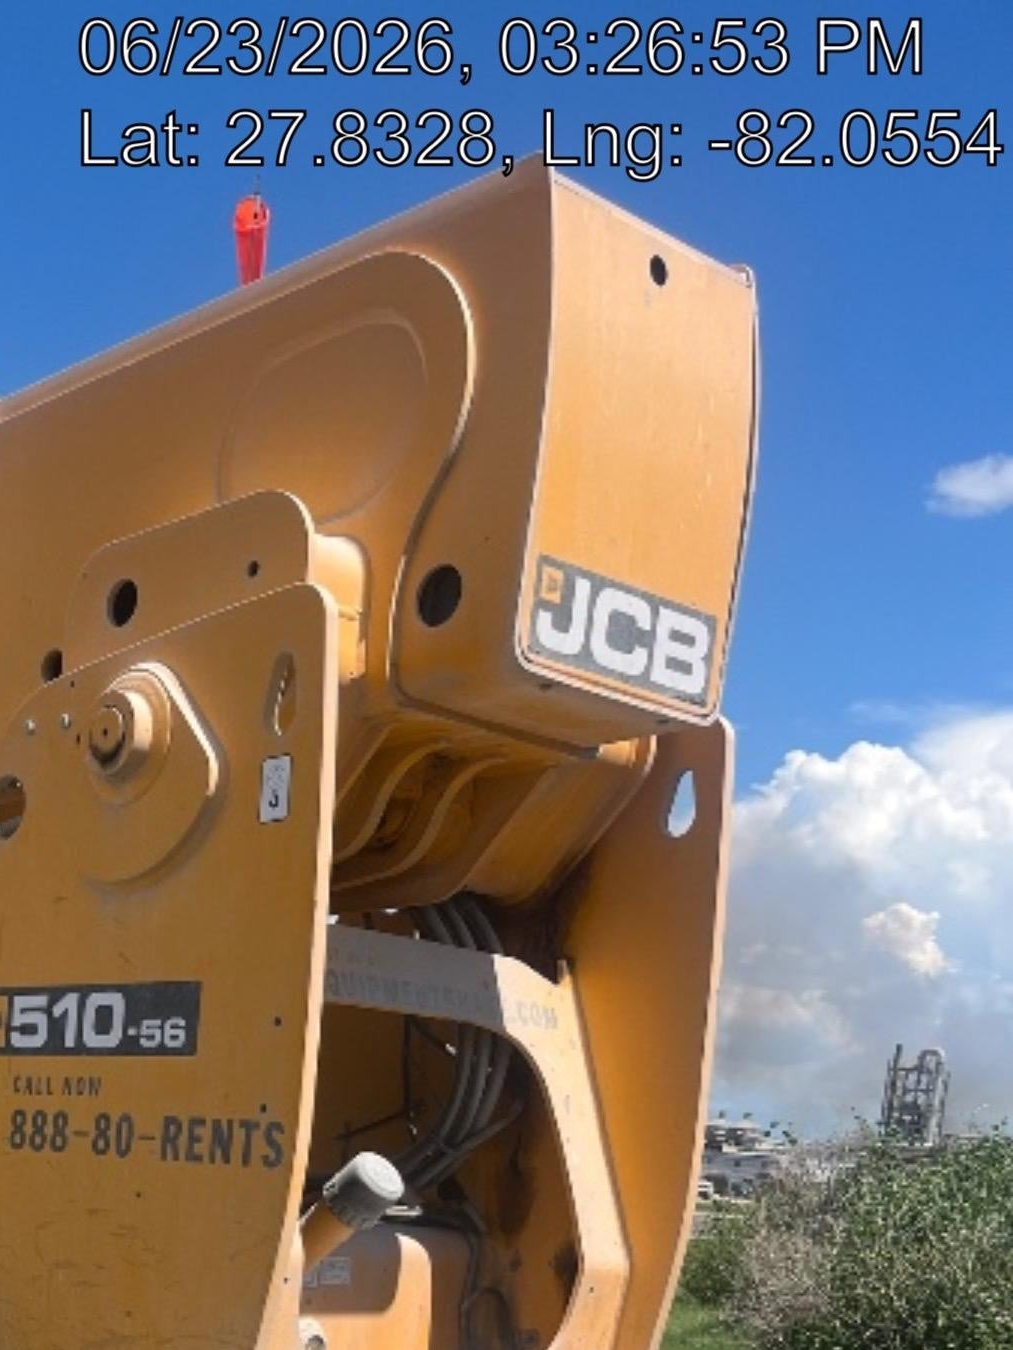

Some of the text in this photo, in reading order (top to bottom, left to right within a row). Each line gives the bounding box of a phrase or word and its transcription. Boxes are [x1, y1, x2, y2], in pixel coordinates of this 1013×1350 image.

[536, 575, 710, 694] JCB
[10, 991, 187, 1049] 510-56
[13, 1075, 103, 1097] CALL NOW
[9, 1109, 286, 1168] 888-80-RENTS
